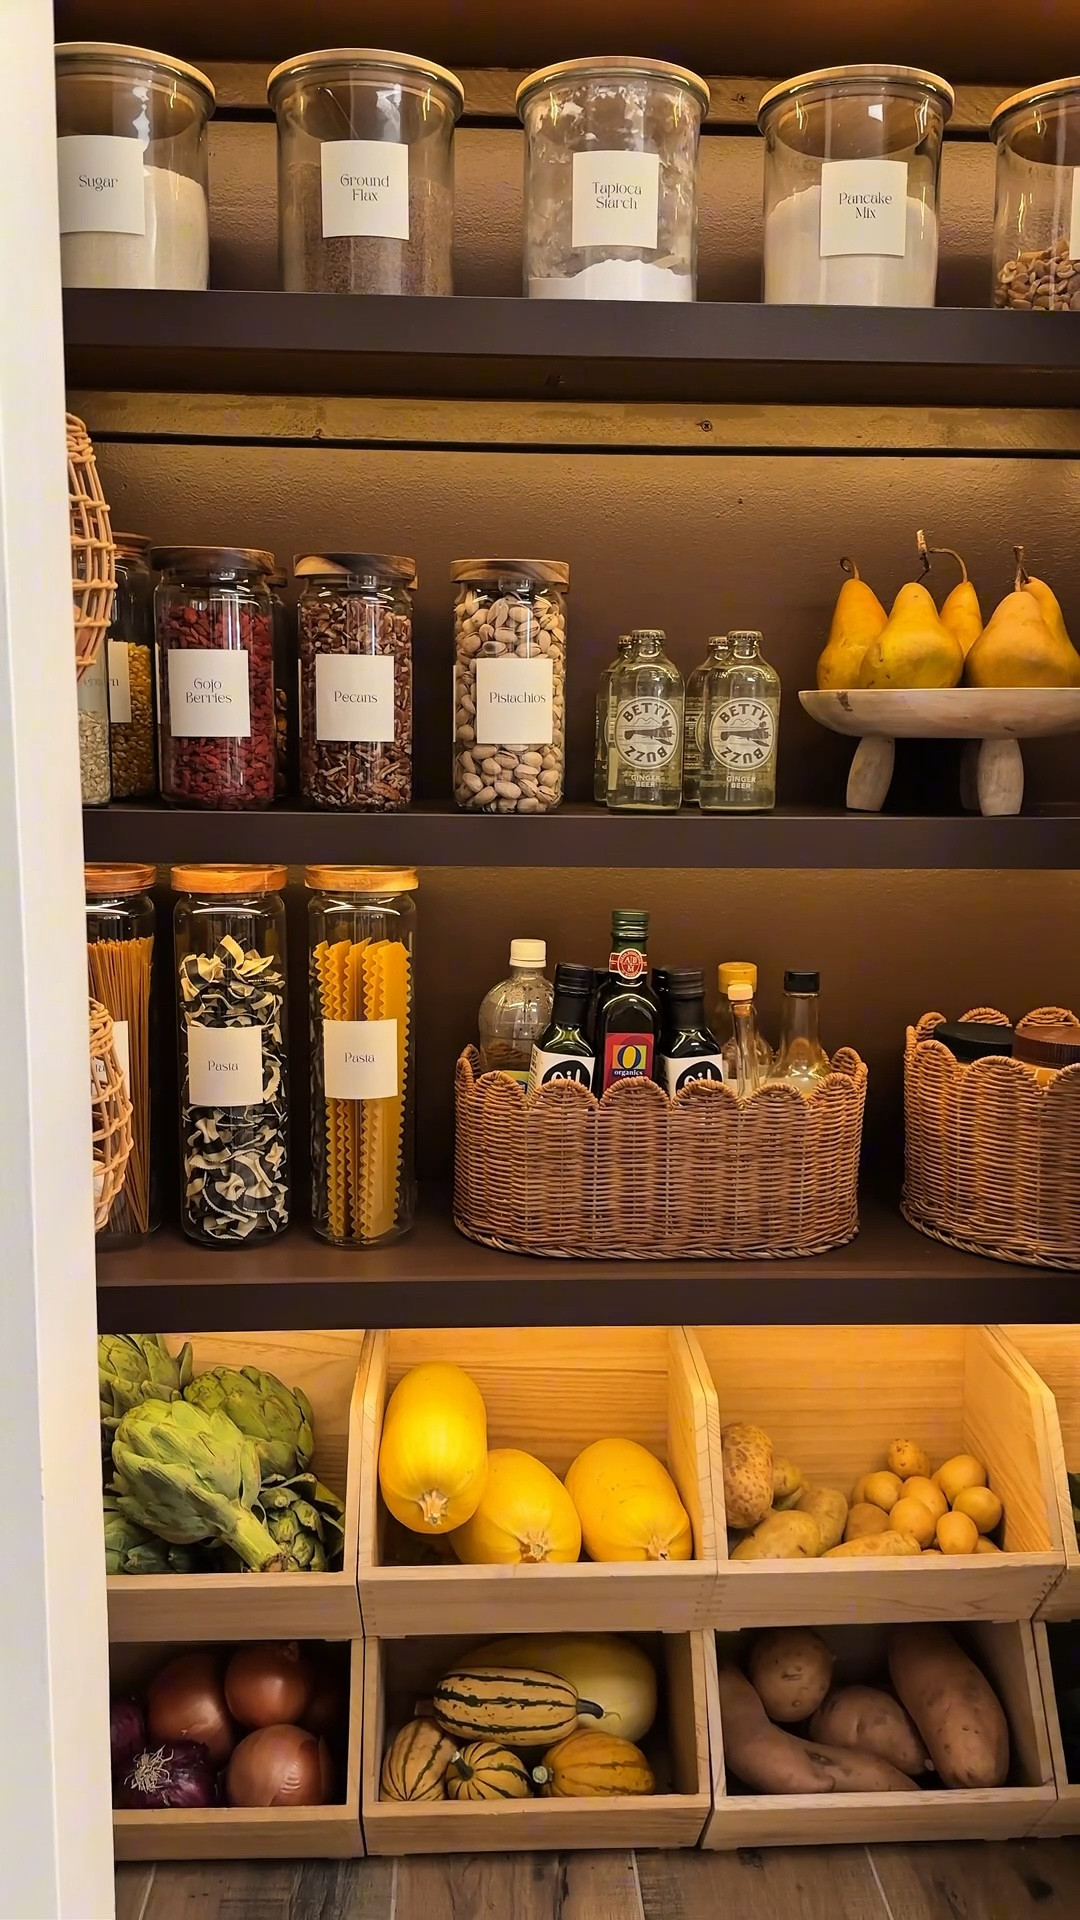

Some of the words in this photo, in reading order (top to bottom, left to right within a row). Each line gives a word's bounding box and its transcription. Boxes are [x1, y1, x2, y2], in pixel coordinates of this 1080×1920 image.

[79, 174, 118, 192] Sugar
[340, 173, 389, 188] Ground
[352, 188, 378, 202] Flax
[592, 181, 642, 198] Tapioca
[595, 194, 638, 210] Starch
[839, 191, 893, 205] Pancake
[855, 206, 876, 219] Mix
[193, 678, 222, 692] Gojo
[185, 691, 233, 704] Berries
[334, 690, 378, 703] Pecans
[489, 691, 546, 704] Pistachios
[623, 703, 671, 723] BETTY
[719, 704, 768, 724] BETTY
[624, 745, 668, 762] BUZZ
[720, 746, 764, 764] BUZZ
[344, 1052, 375, 1063] Pasta
[207, 1060, 239, 1072] Pasta
[613, 1069, 644, 1077] organics
